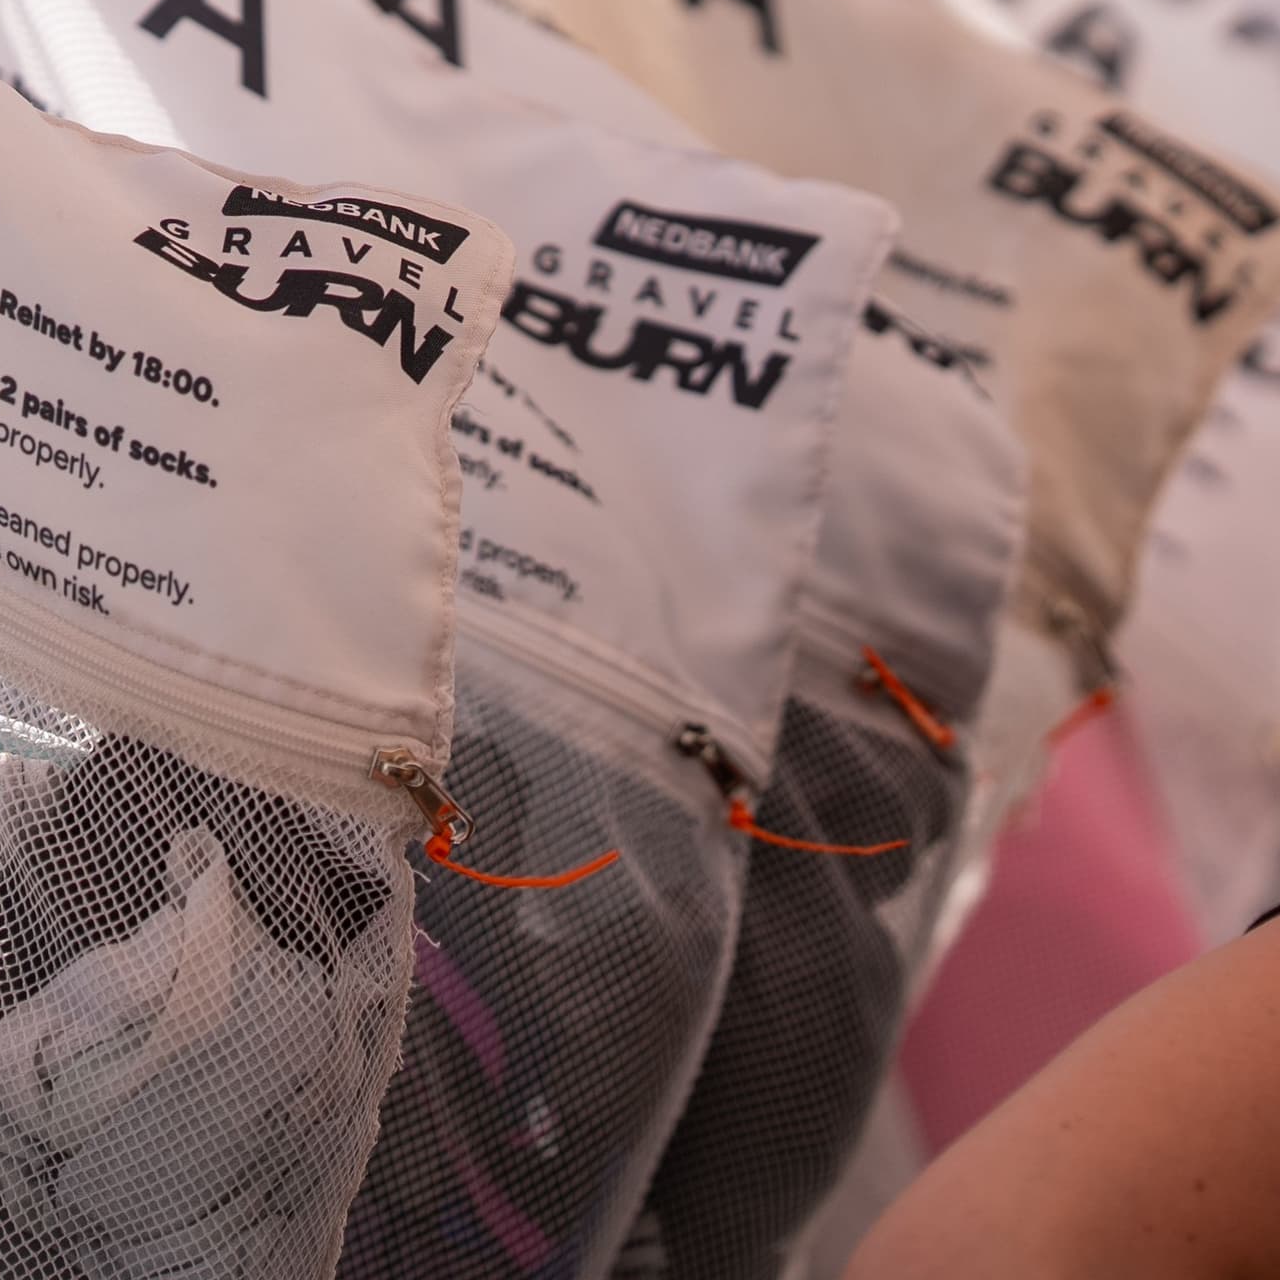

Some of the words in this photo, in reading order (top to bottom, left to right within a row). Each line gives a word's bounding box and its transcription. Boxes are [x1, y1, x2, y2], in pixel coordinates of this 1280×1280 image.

[159, 218, 465, 324] GRAVEL
[613, 209, 792, 277] NEDBANK
[533, 244, 801, 342] GRAVEL
[89, 331, 126, 372] by
[131, 351, 220, 408] 18:00.
[500, 279, 794, 410] BURN
[21, 391, 89, 438] pairs
[93, 425, 125, 452] of
[128, 439, 218, 488] socks.
[6, 549, 57, 591] own
[62, 576, 110, 616] risk.
[77, 543, 194, 607] properly.
